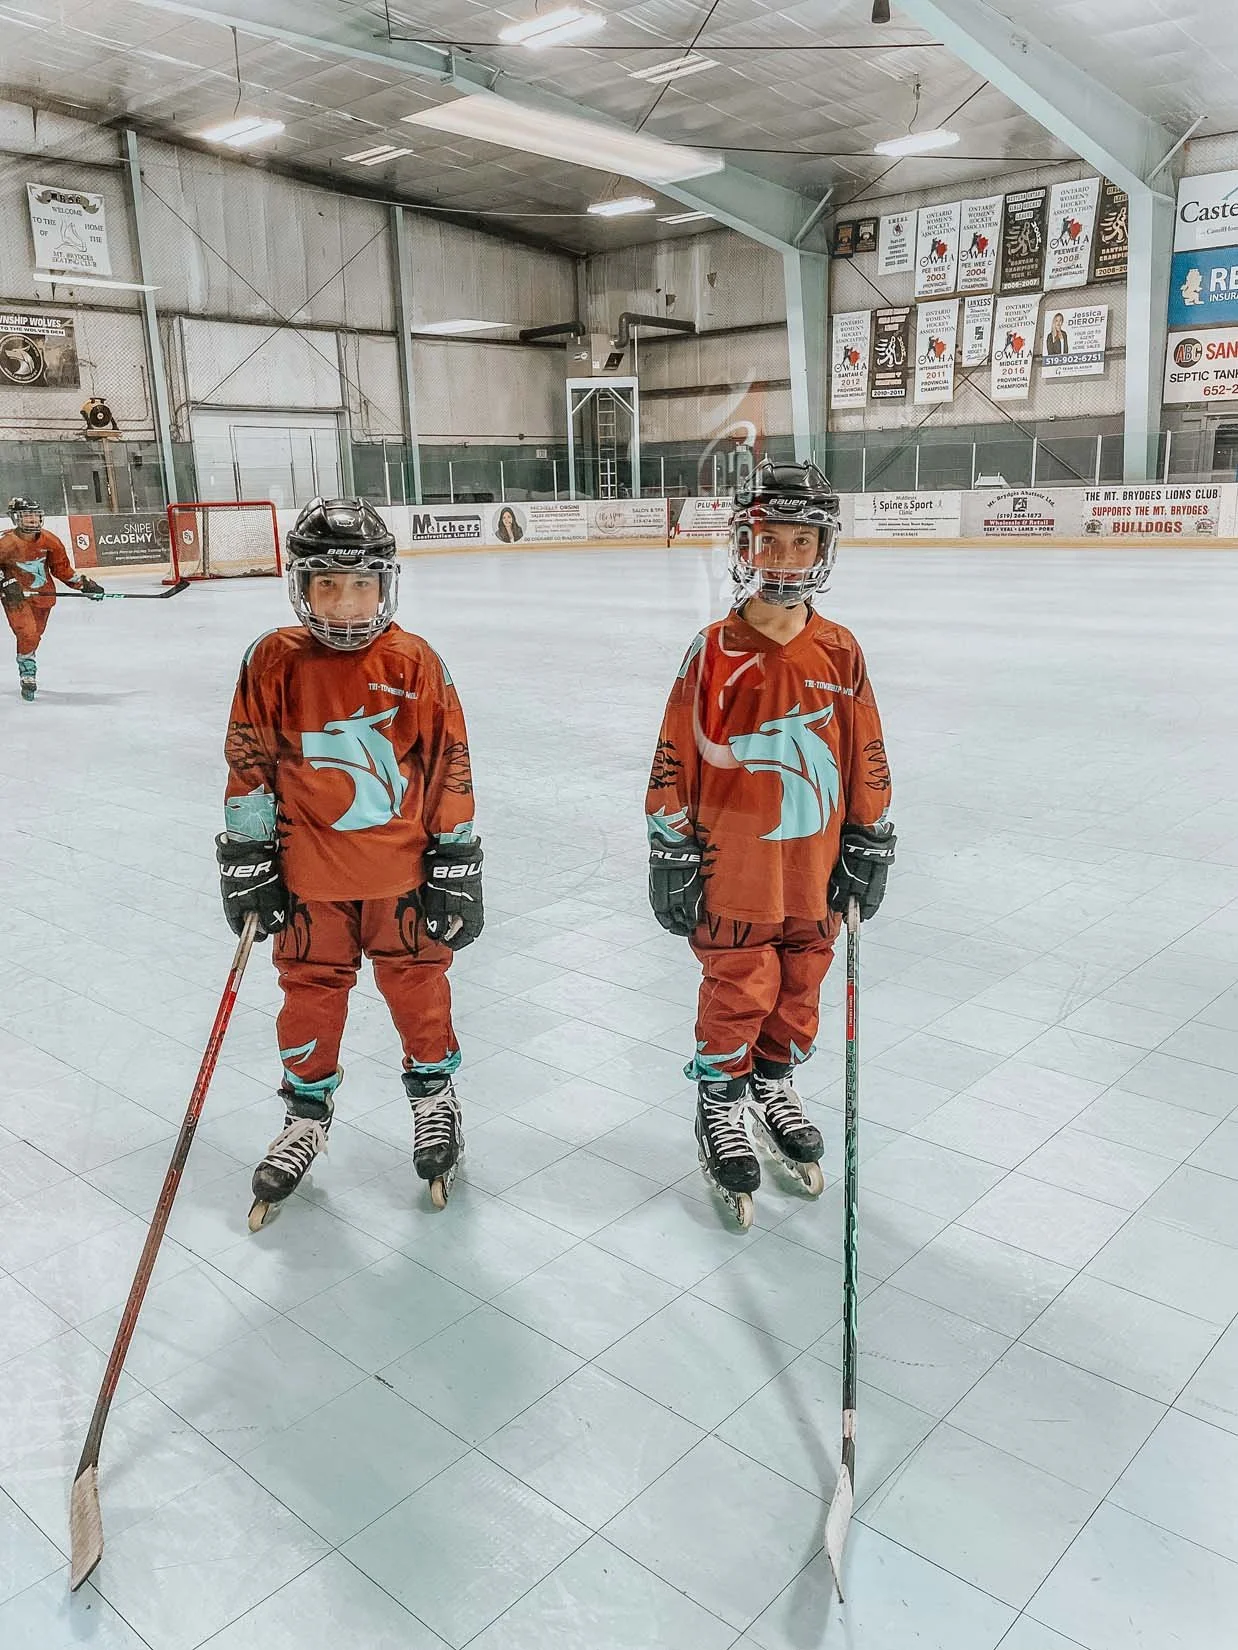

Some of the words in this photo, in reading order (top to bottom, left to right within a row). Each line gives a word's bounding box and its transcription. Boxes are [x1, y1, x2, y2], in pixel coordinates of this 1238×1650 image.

[1060, 186, 1090, 195] ONTARIO
[52, 207, 82, 216] WELCOME
[926, 210, 952, 219] ONTARIO
[1057, 255, 1079, 264] 2008
[1051, 264, 1083, 273] PROVINCIAL
[926, 273, 946, 282] 2003
[1072, 310, 1102, 318] Jessica
[0, 316, 28, 325] NSHIP
[30, 318, 61, 328] WOLVES
[1068, 316, 1105, 326] DIEROFF
[1176, 342, 1201, 363] ABC
[1046, 354, 1100, 365] 519-902-6751
[1002, 367, 1024, 375] 2016
[1170, 370, 1210, 383] SEPTIC
[997, 492, 1019, 500] Brydges
[1085, 492, 1100, 501] THE
[1104, 491, 1119, 500] MT.
[1123, 490, 1162, 500] BRYDGES
[1166, 490, 1191, 500] LIONS
[880, 501, 902, 512] Spine
[910, 500, 933, 511] Sport
[1092, 506, 1131, 516] SUPPORTS
[1135, 506, 1149, 515] THE
[1153, 506, 1167, 515] MT.
[1170, 505, 1208, 515] BRYDGES
[124, 522, 152, 534] SNIPE
[1112, 521, 1183, 533] BULLDOGS
[98, 533, 152, 544] ACADEMY
